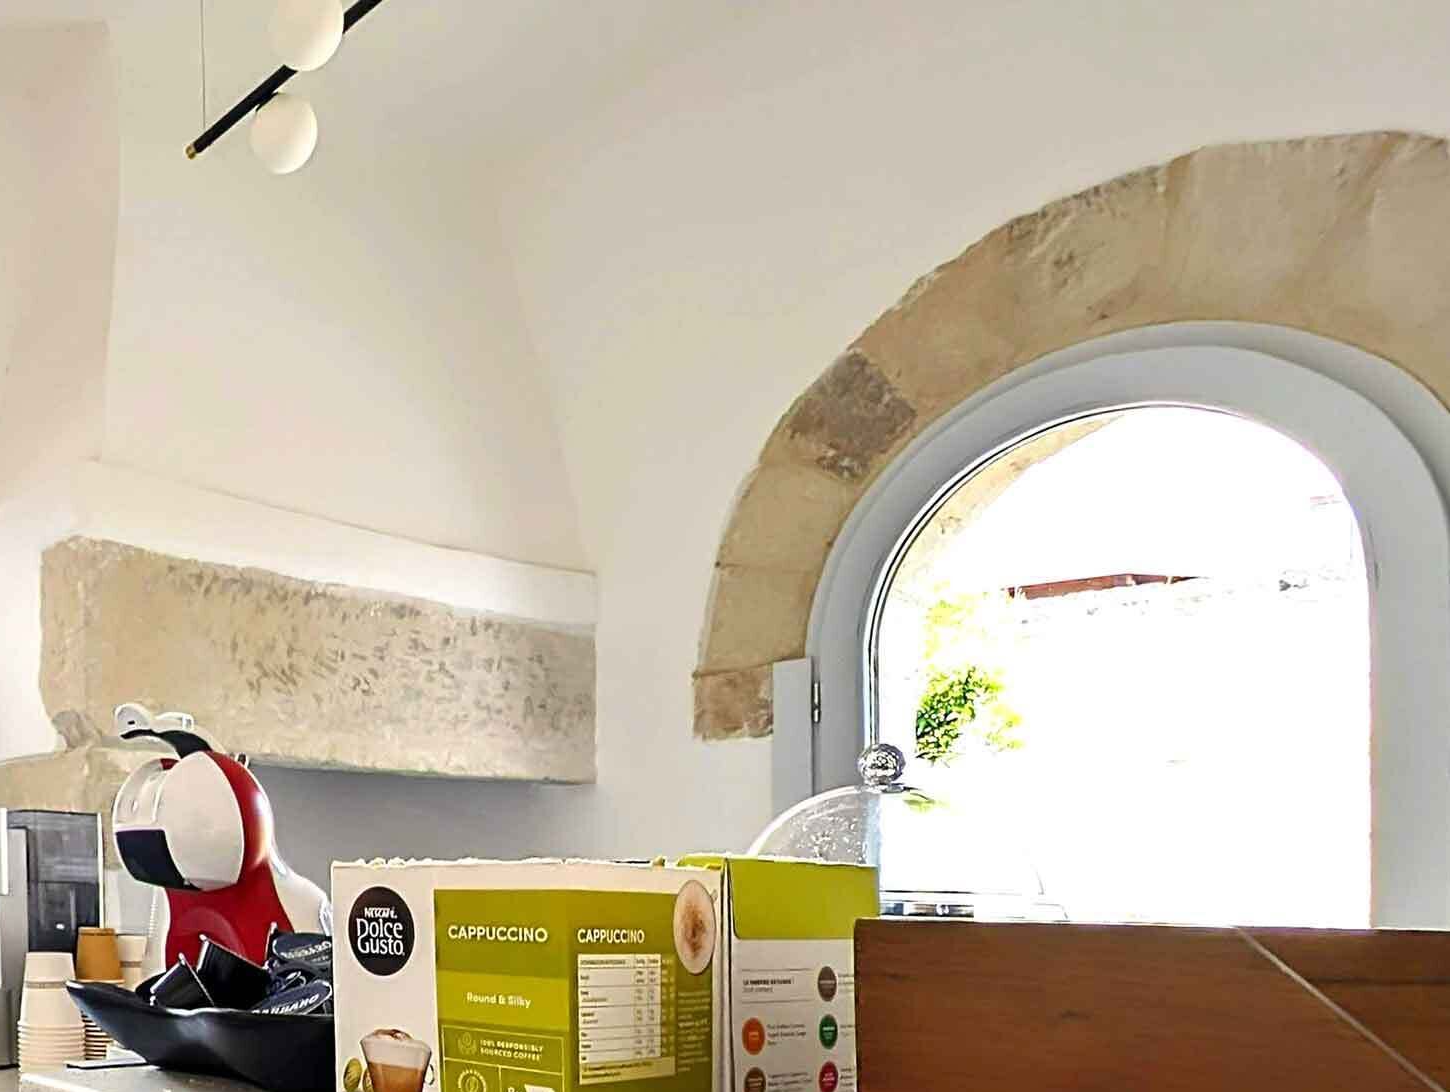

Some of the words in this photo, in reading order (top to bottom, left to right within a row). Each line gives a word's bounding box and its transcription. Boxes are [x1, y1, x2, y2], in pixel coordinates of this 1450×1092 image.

[356, 918, 404, 939] Dolce
[447, 925, 549, 943] CAPPUCCINO
[577, 928, 645, 944] CAPPUCCINO
[357, 936, 404, 956] Gusto
[466, 991, 497, 1005] Round
[507, 996, 532, 1009] Silky
